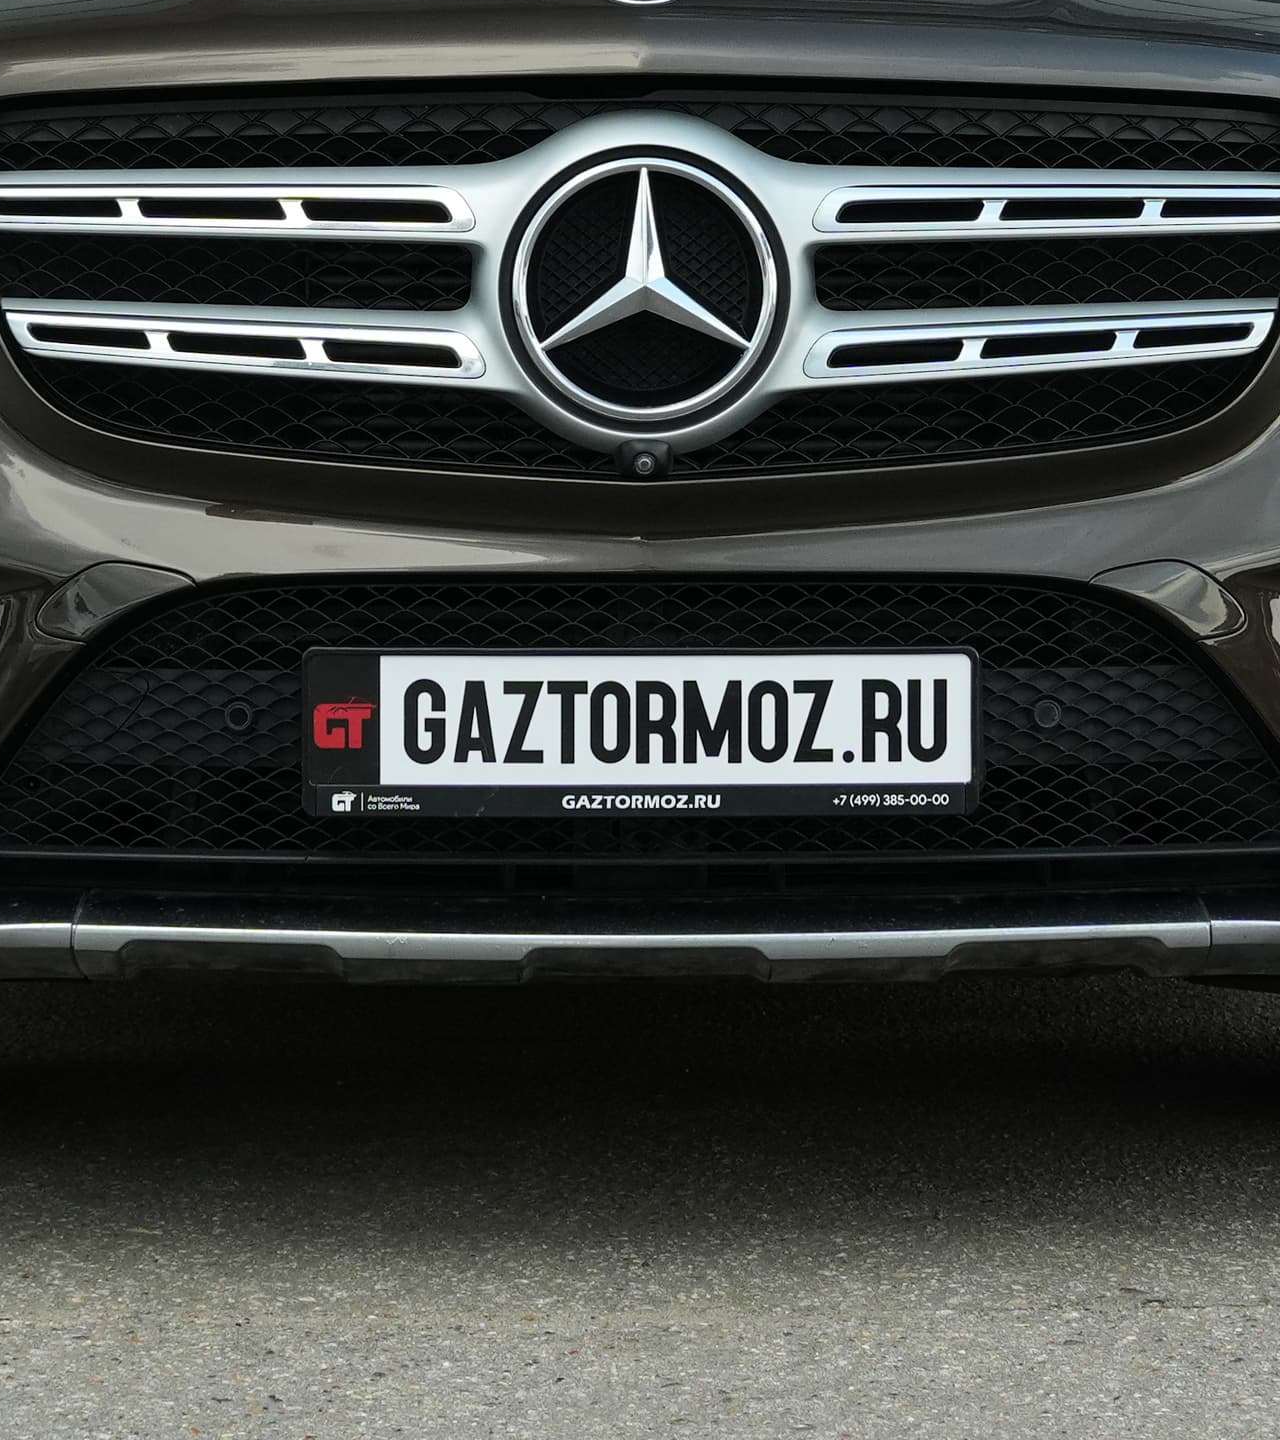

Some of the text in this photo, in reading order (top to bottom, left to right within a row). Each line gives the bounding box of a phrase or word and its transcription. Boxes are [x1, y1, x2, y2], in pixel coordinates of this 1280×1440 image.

[313, 702, 374, 750] GT
[403, 678, 948, 765] GAZTORMOZ.RU
[331, 791, 357, 812] GT
[561, 794, 721, 809] GAZTORMOZ.RU
[833, 793, 949, 807] +7 (499) 385-00-00
